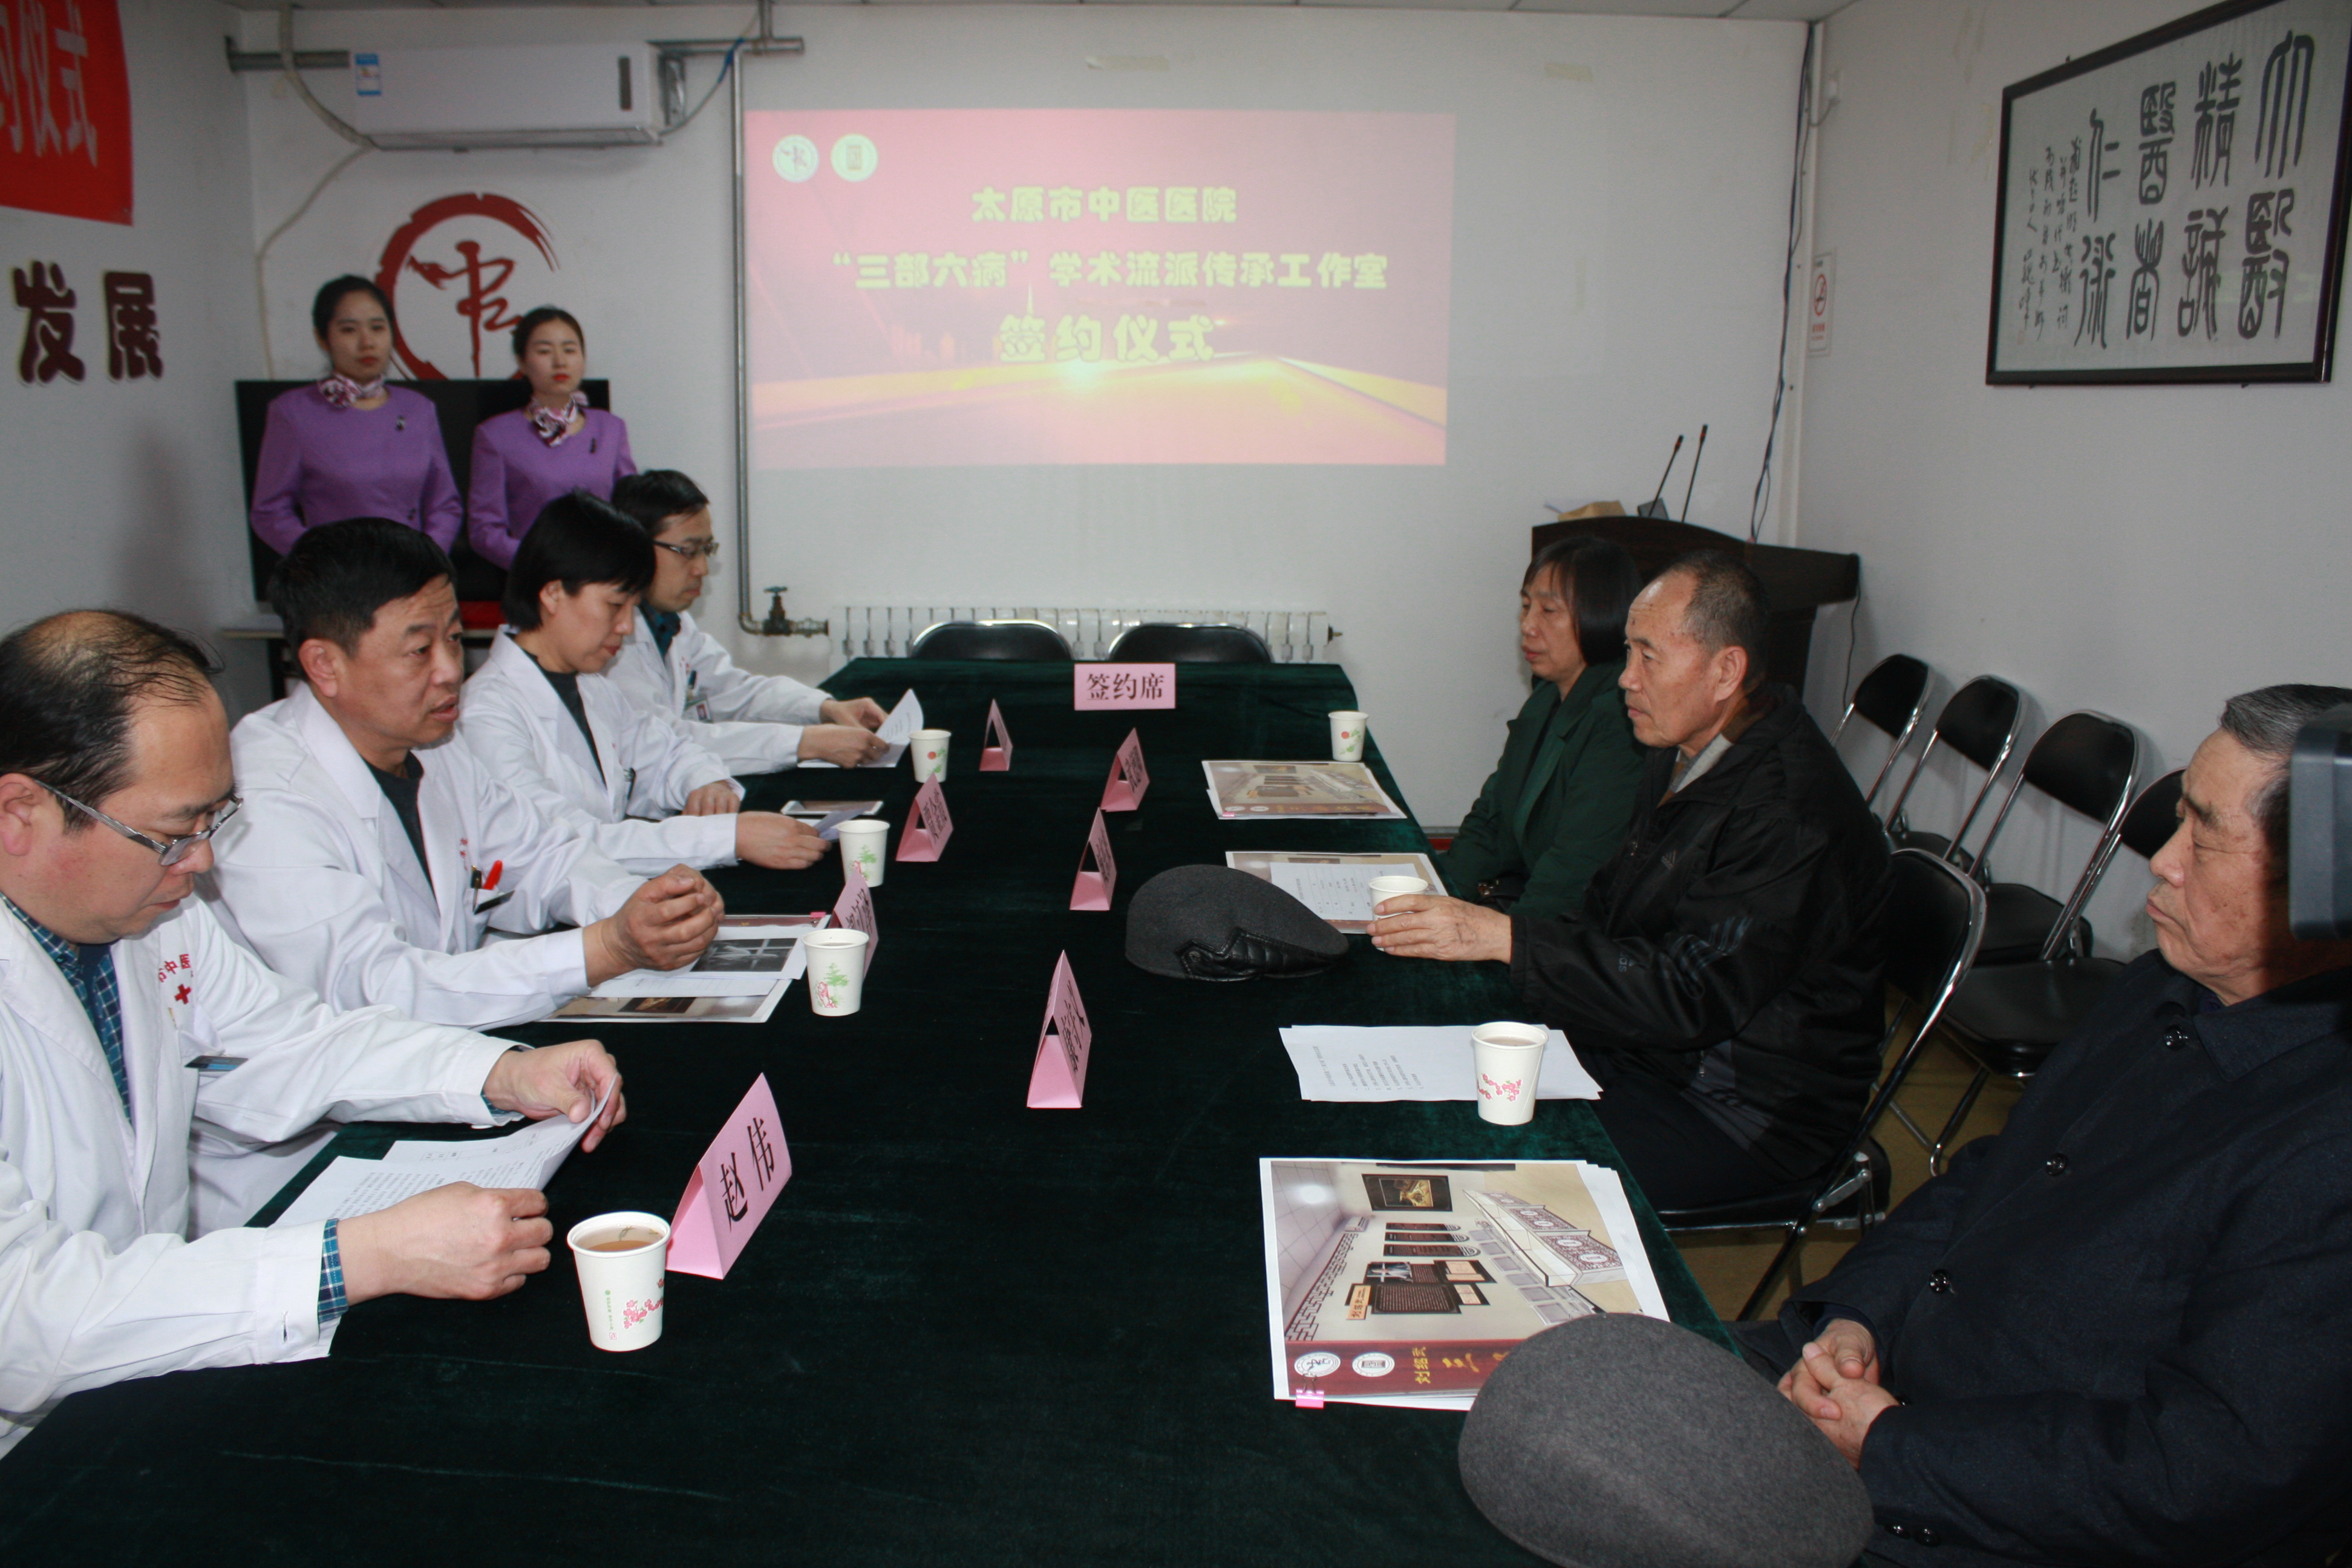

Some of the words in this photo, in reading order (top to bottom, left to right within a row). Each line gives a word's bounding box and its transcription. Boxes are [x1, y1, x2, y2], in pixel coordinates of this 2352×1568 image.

[971, 186, 1238, 223] 太原市中医医院
[12, 260, 164, 385] 发展
[999, 315, 1214, 362] 签约仪式
[1086, 673, 1165, 701] 签约席
[720, 1117, 776, 1233] 赵伟
[1411, 1346, 1432, 1385] 刘绍武
